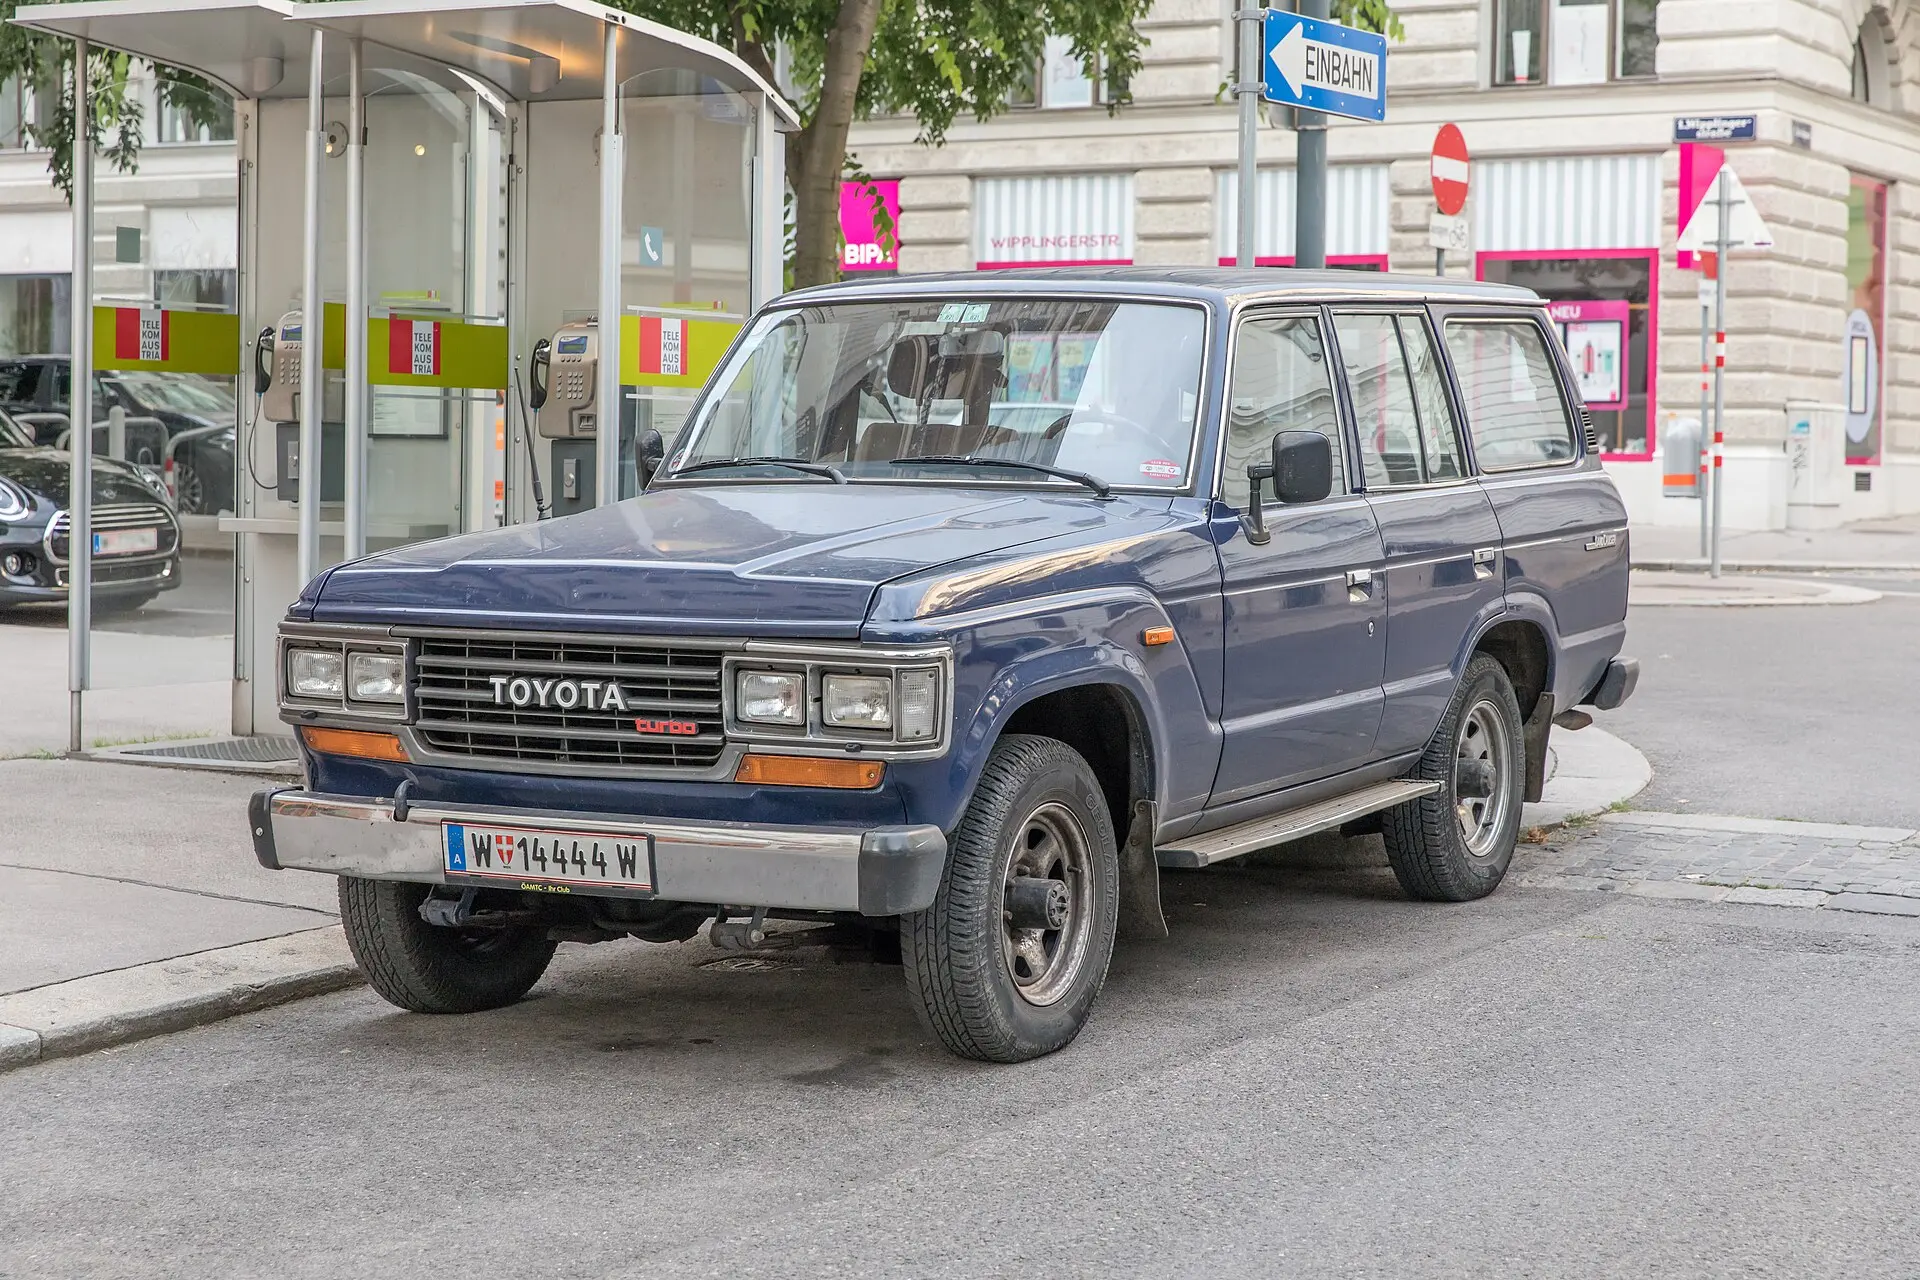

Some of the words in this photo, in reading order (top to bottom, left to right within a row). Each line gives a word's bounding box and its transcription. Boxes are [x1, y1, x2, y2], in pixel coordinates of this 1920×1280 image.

[1306, 45, 1372, 92] EINBAHN
[1551, 305, 1581, 319] NEU
[141, 320, 160, 330] TELE
[141, 331, 160, 340] KOM
[414, 333, 432, 342] TELE
[662, 331, 679, 341] TELE
[141, 341, 160, 350] AUS
[414, 343, 432, 352] KOM
[662, 342, 679, 351] KOM
[141, 350, 160, 360] TRIA
[414, 355, 432, 364] AUS
[662, 353, 679, 363] AUS
[414, 364, 432, 374] TRIA
[662, 364, 679, 373] TRIA
[489, 677, 627, 711] TOYOTA
[635, 717, 698, 735] turbo
[453, 853, 462, 865] A
[472, 832, 492, 868] W
[517, 837, 608, 877] 14444
[616, 844, 637, 879] W
[521, 881, 543, 891] ÖAMTC
